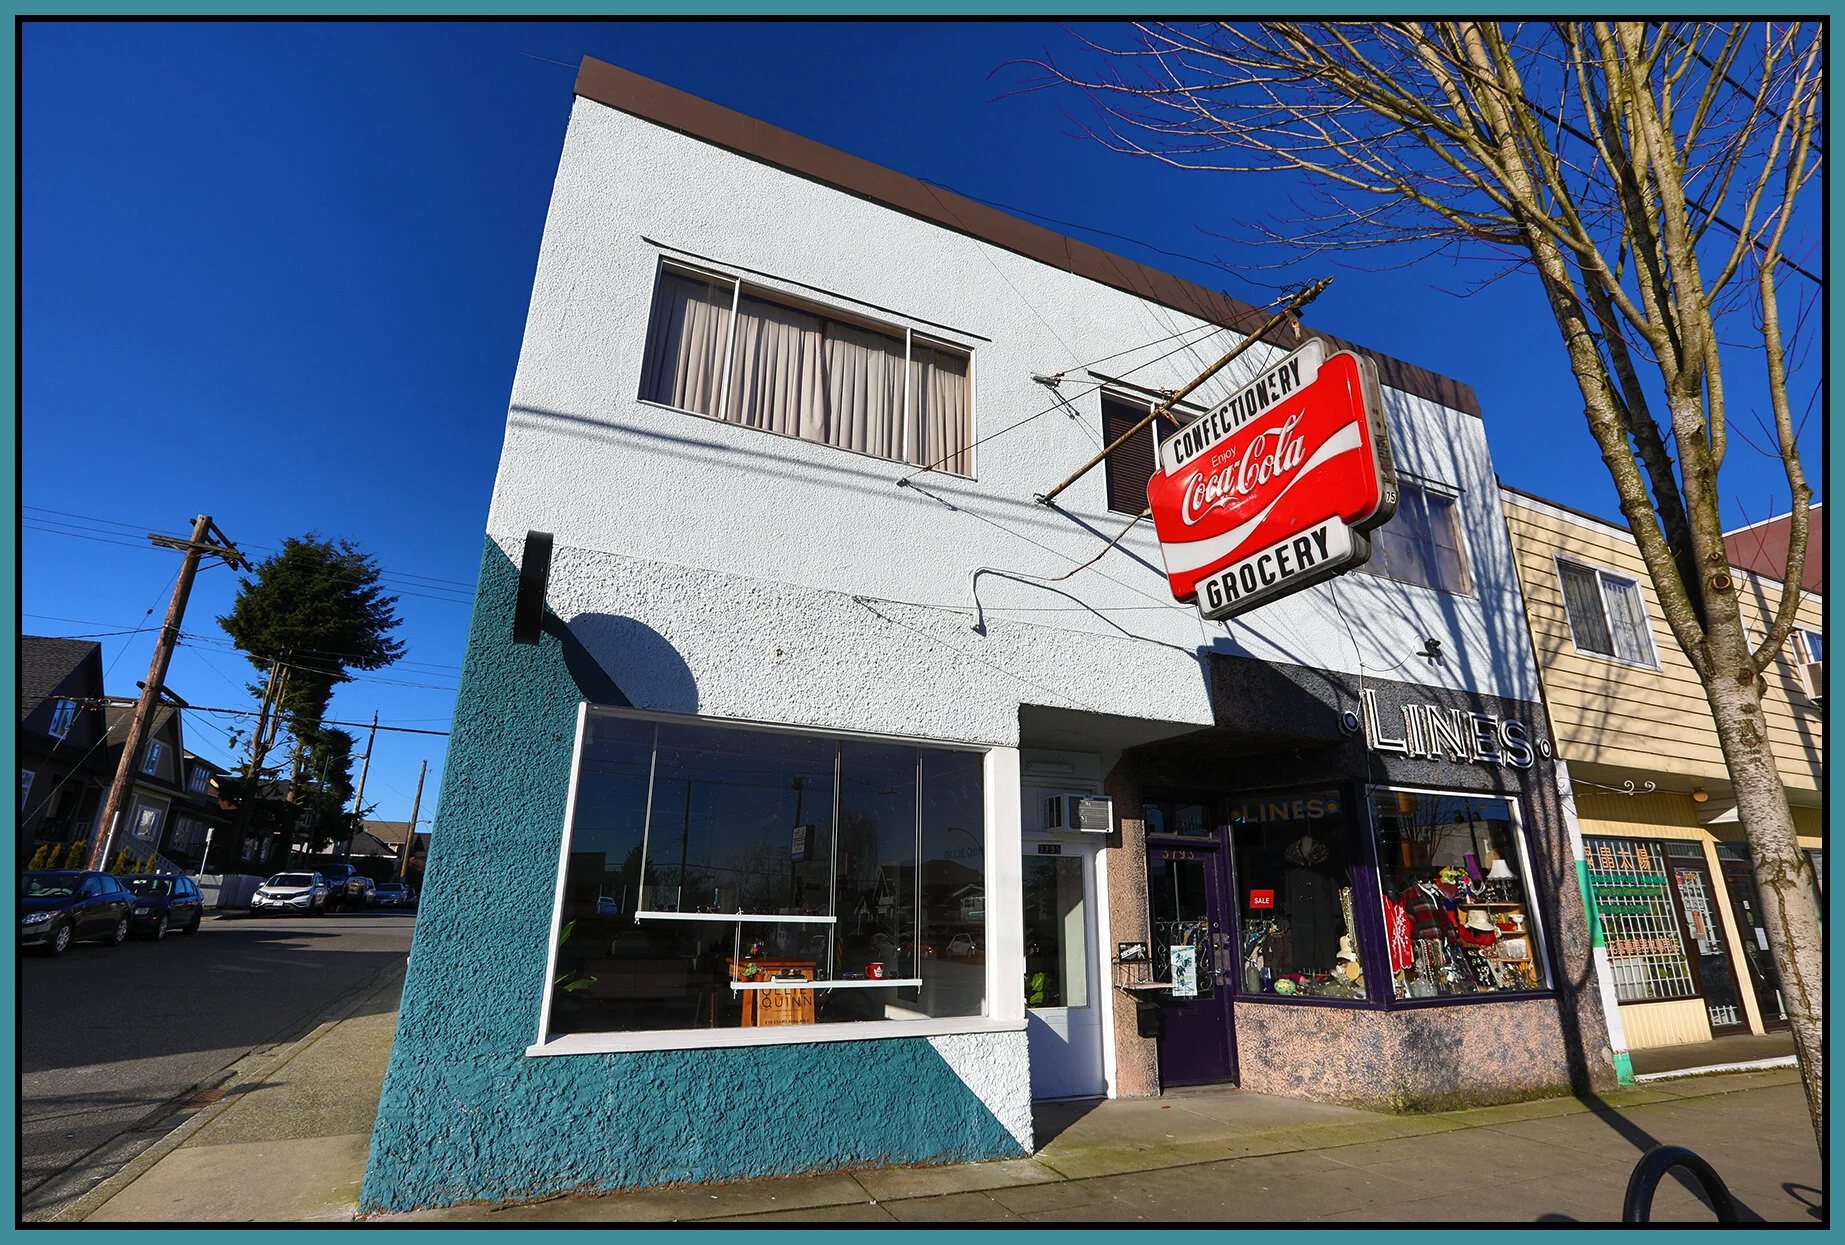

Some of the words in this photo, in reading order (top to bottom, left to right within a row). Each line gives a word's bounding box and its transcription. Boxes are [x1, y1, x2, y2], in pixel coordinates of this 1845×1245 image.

[1173, 357, 1301, 465] CONFECTIONERY
[1181, 407, 1308, 526] Coca-Cola
[1211, 444, 1237, 467] Enjoy
[1386, 490, 1396, 503] 75
[1205, 526, 1329, 609] GROCERY
[1359, 688, 1535, 769] LINES
[1241, 799, 1325, 823] LINES
[1254, 897, 1270, 905] SALE
[761, 996, 812, 1009] QUINN
